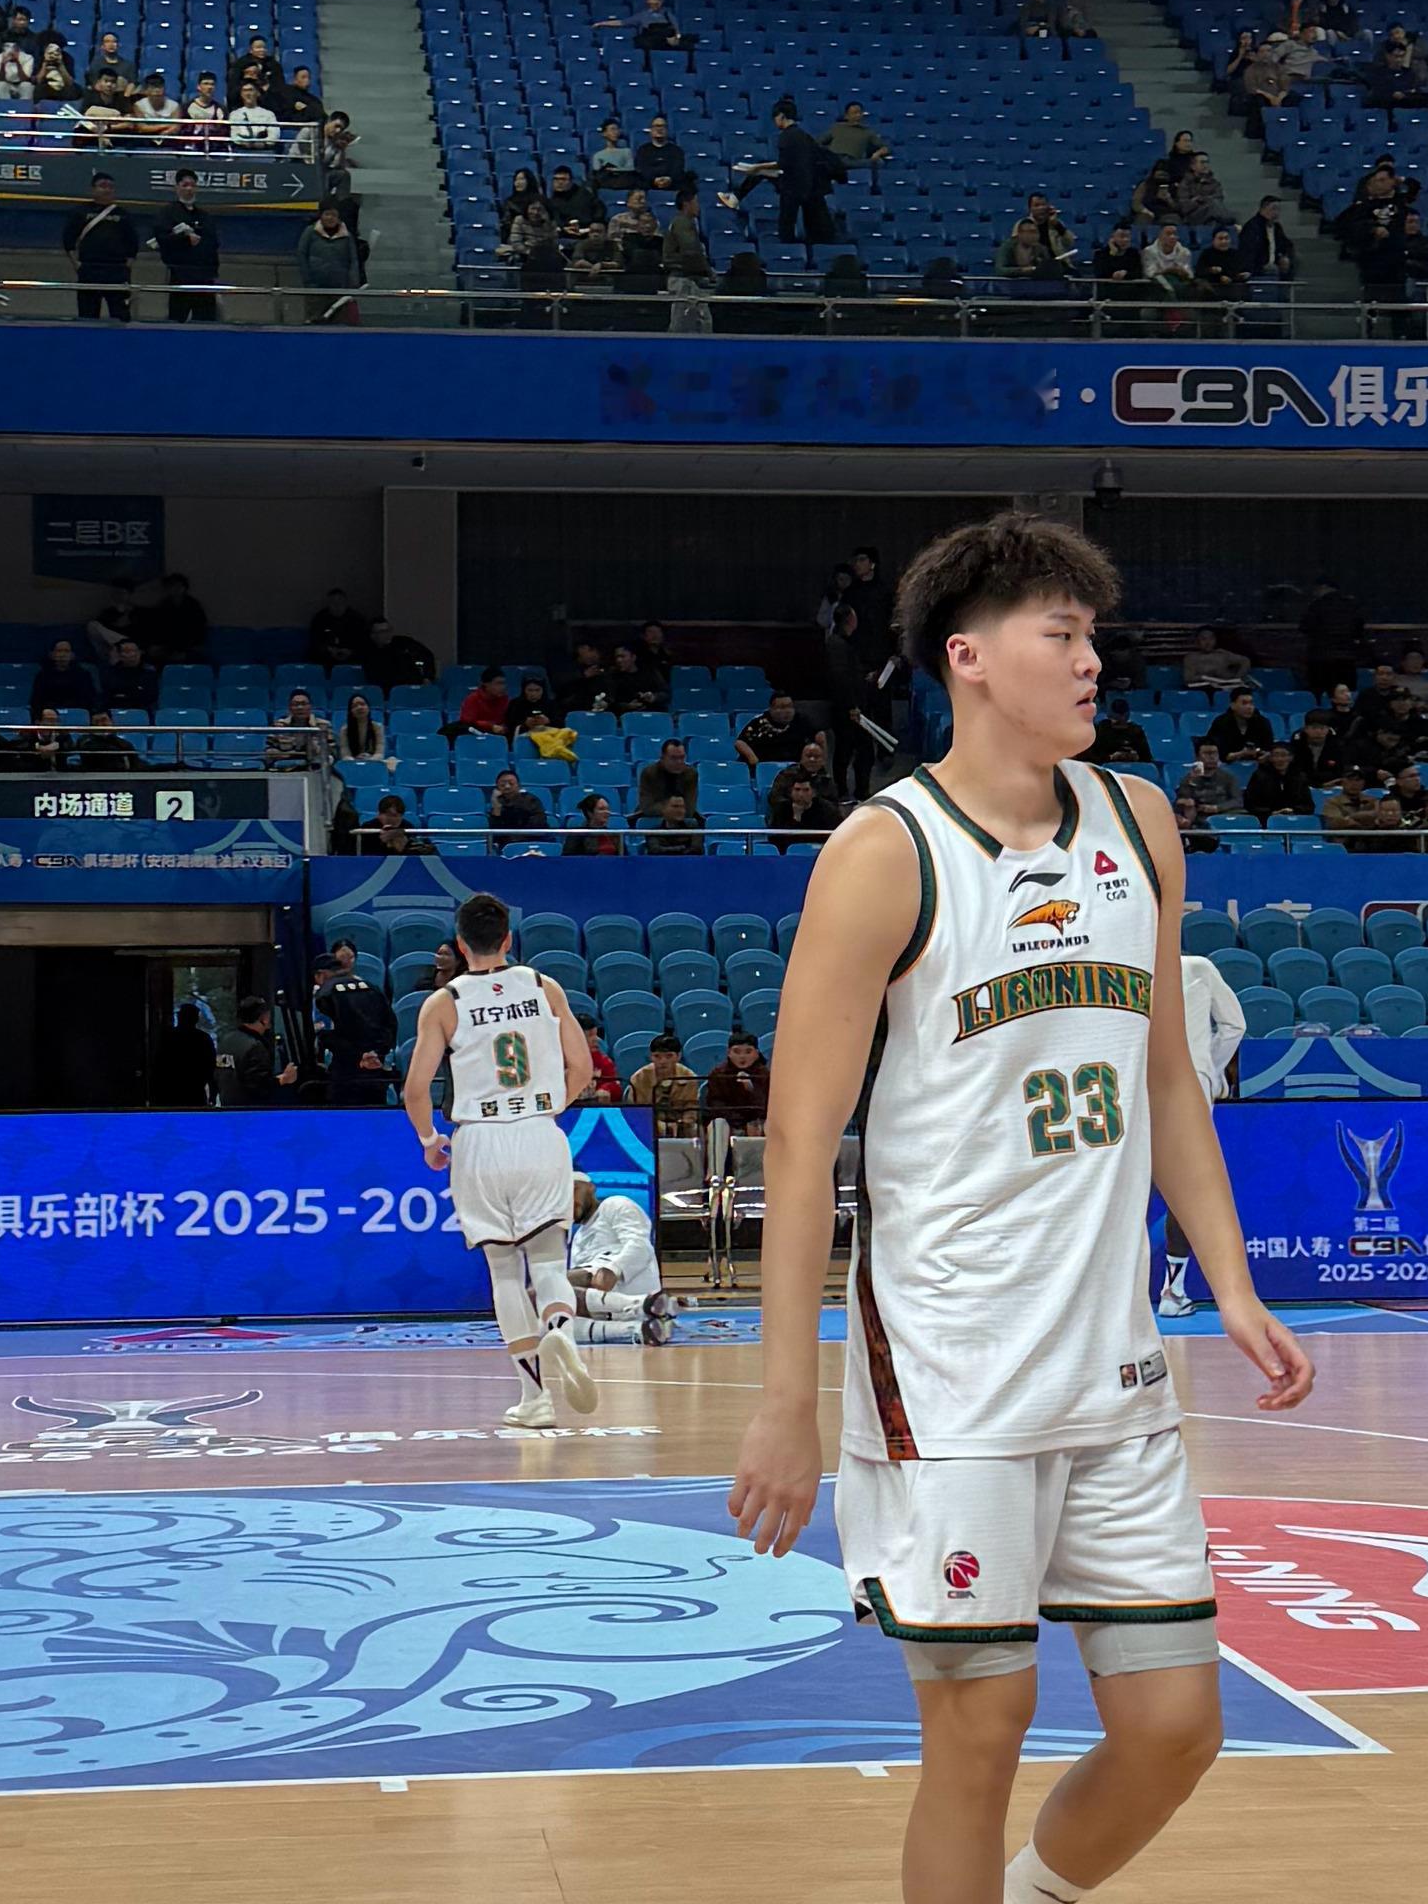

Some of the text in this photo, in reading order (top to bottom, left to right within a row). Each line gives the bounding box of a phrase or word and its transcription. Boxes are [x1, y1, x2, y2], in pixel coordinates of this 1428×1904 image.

[34, 793, 134, 818] 内场通道
[952, 961, 1153, 1045] LIAONING
[492, 1030, 532, 1088] 9
[1023, 1062, 1126, 1158] 23
[174, 1185, 460, 1235] 2025-202
[1353, 1216, 1400, 1232] 第二届
[1205, 1527, 1421, 1632] I-NING
